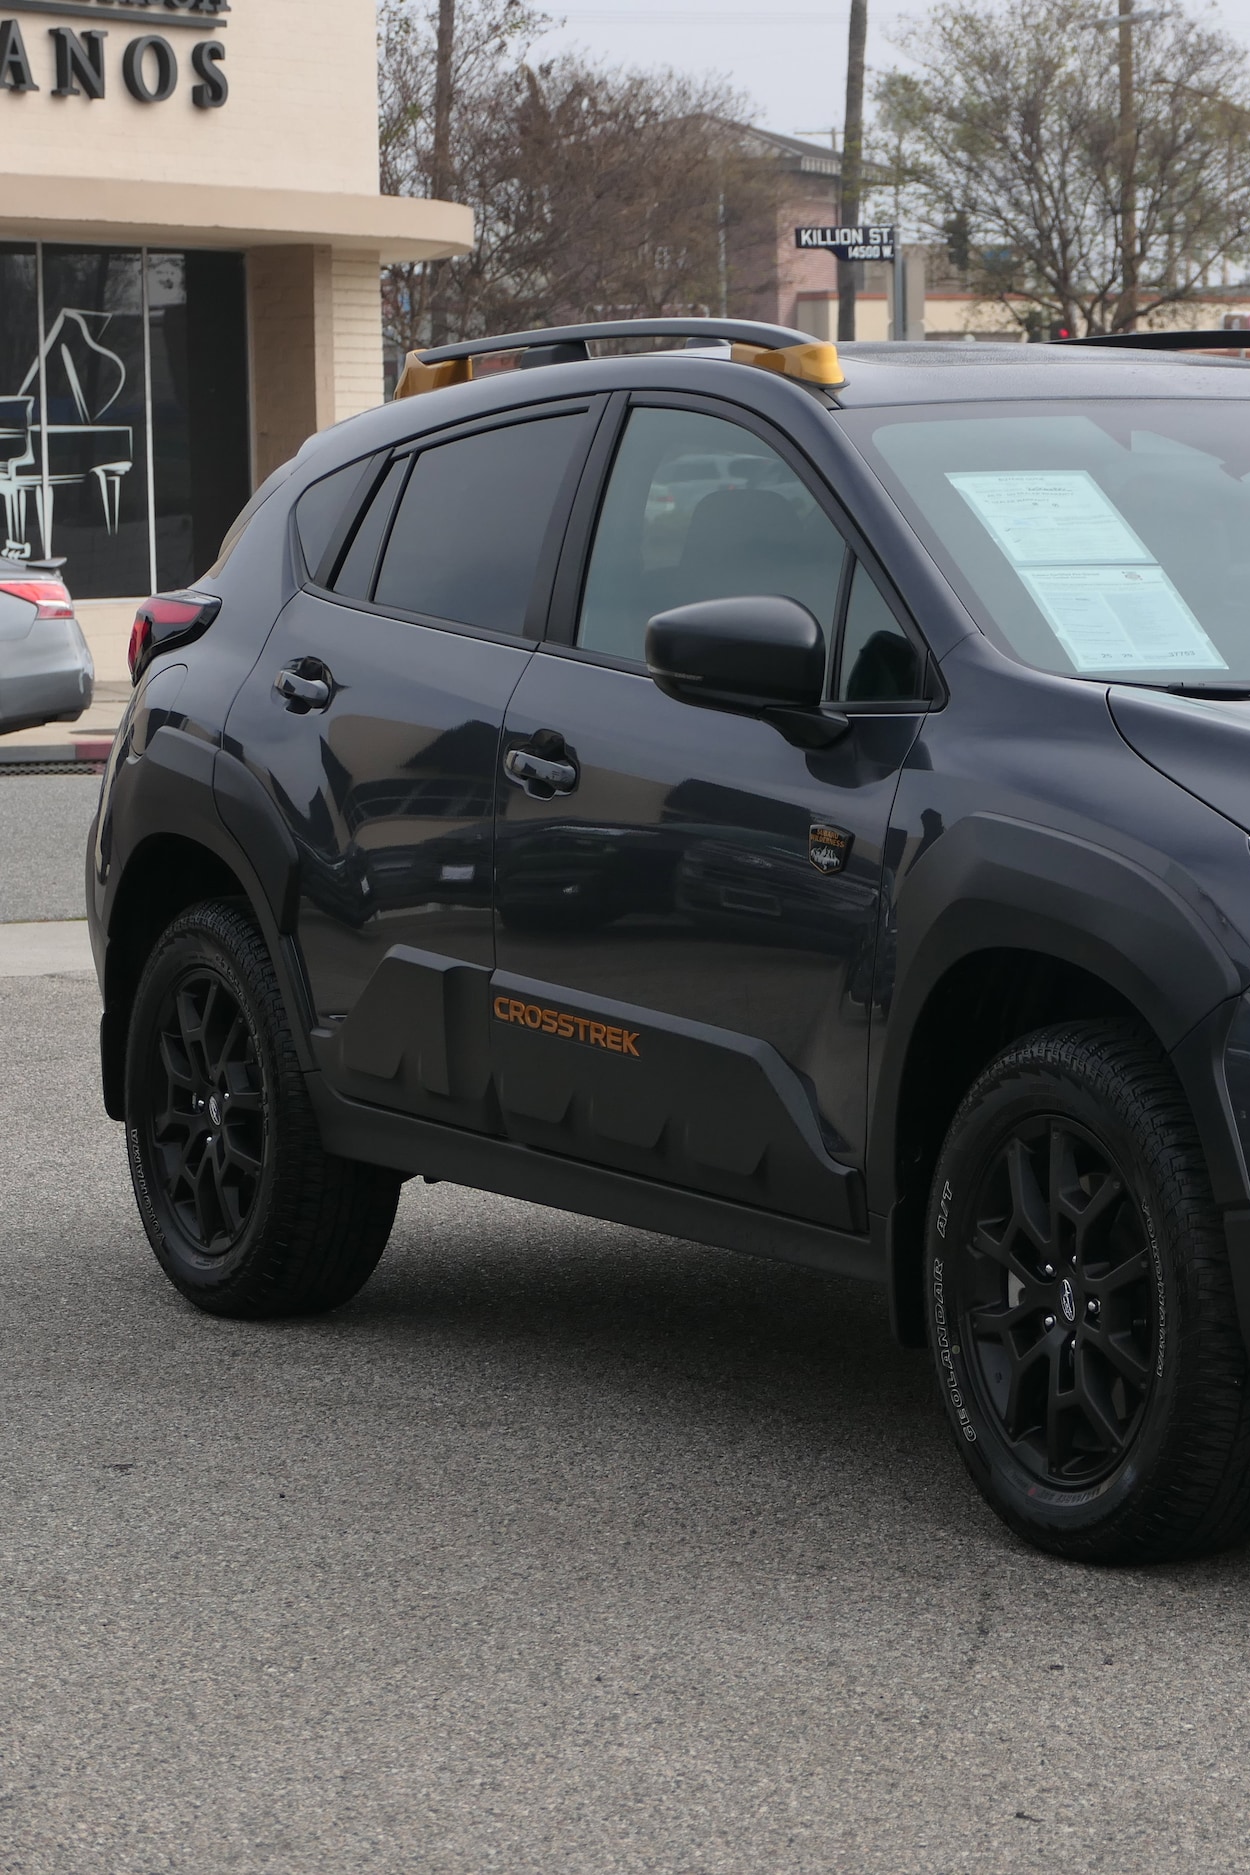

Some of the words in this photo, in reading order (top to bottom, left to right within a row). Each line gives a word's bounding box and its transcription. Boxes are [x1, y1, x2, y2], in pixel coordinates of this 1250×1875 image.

[800, 228, 863, 246] KILLION
[868, 227, 893, 245] ST.
[848, 245, 880, 259] 14500
[881, 245, 894, 258] W.
[492, 996, 640, 1057] CROSSTREK
[936, 1180, 953, 1239] A/T
[928, 1257, 978, 1444] GEOLANDAR
